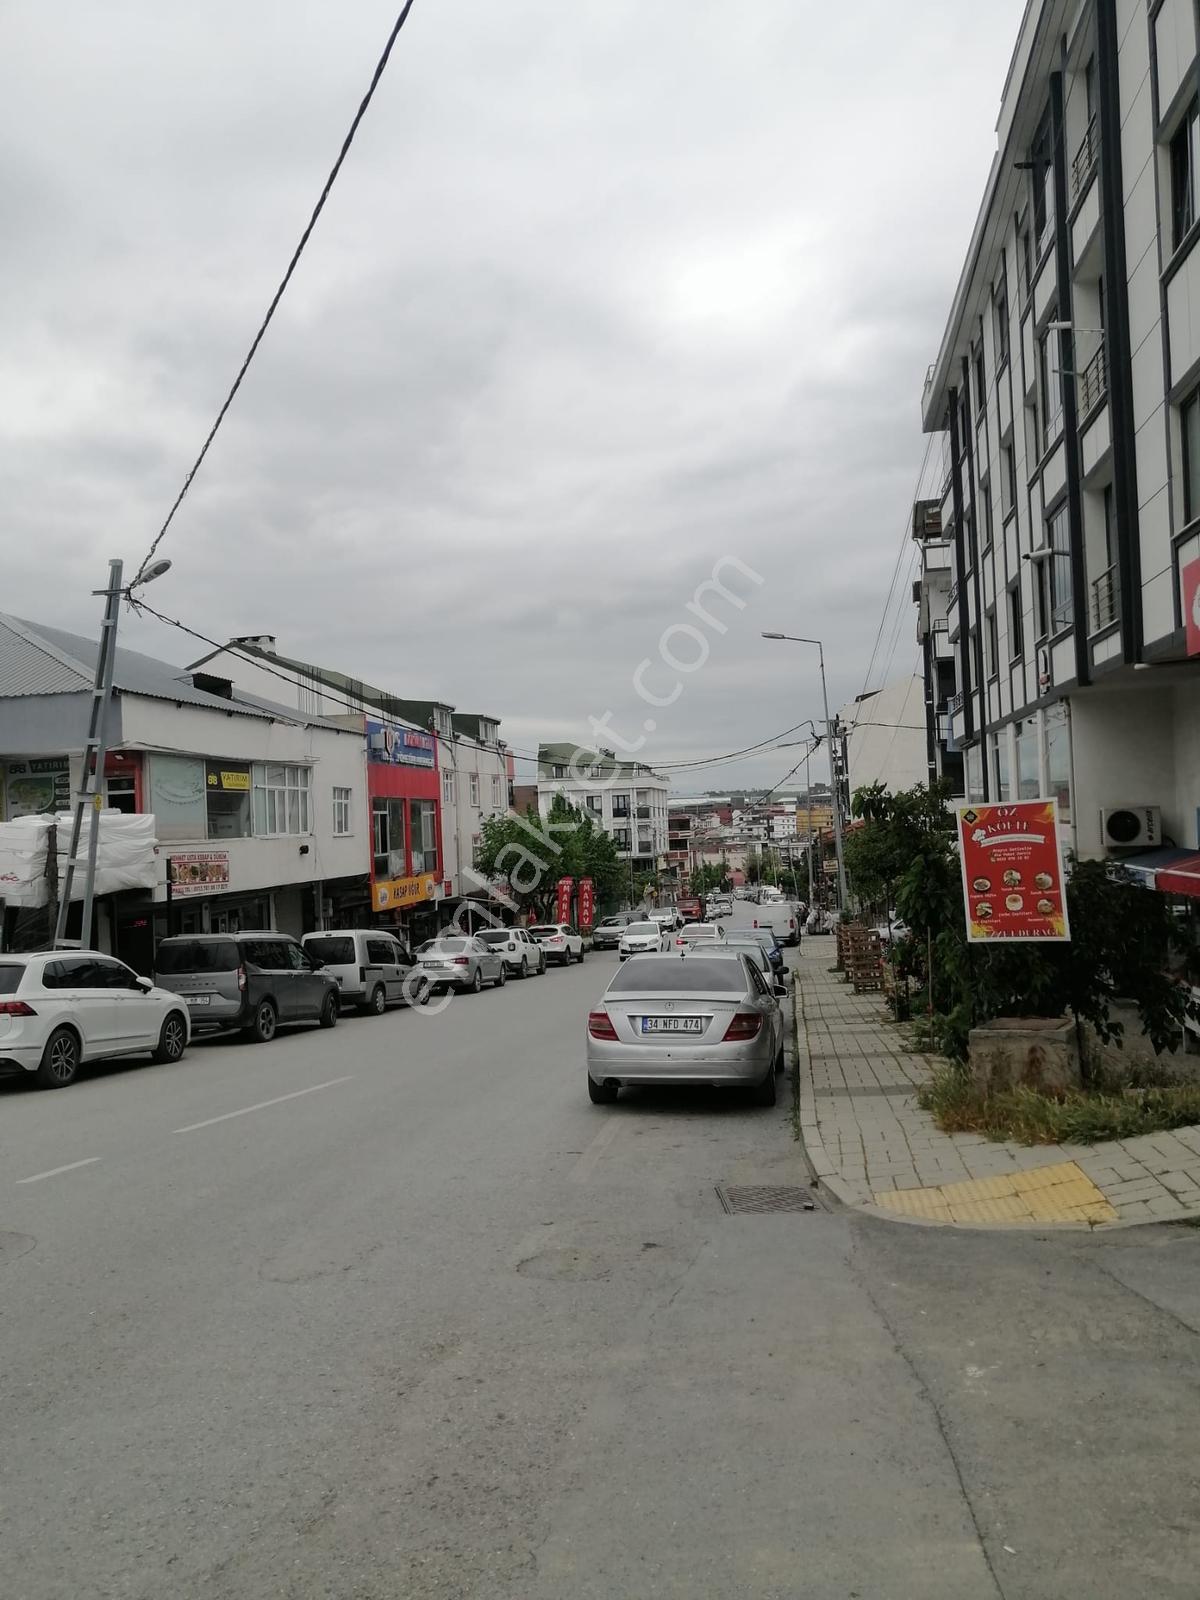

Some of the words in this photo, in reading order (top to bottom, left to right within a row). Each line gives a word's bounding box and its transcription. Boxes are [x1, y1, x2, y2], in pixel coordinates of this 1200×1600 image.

[394, 885, 407, 899] KASAP
[562, 885, 570, 924] MANA
[648, 1019, 658, 1029] 34
[662, 1019, 679, 1029] NFD
[683, 1019, 699, 1029] 474
